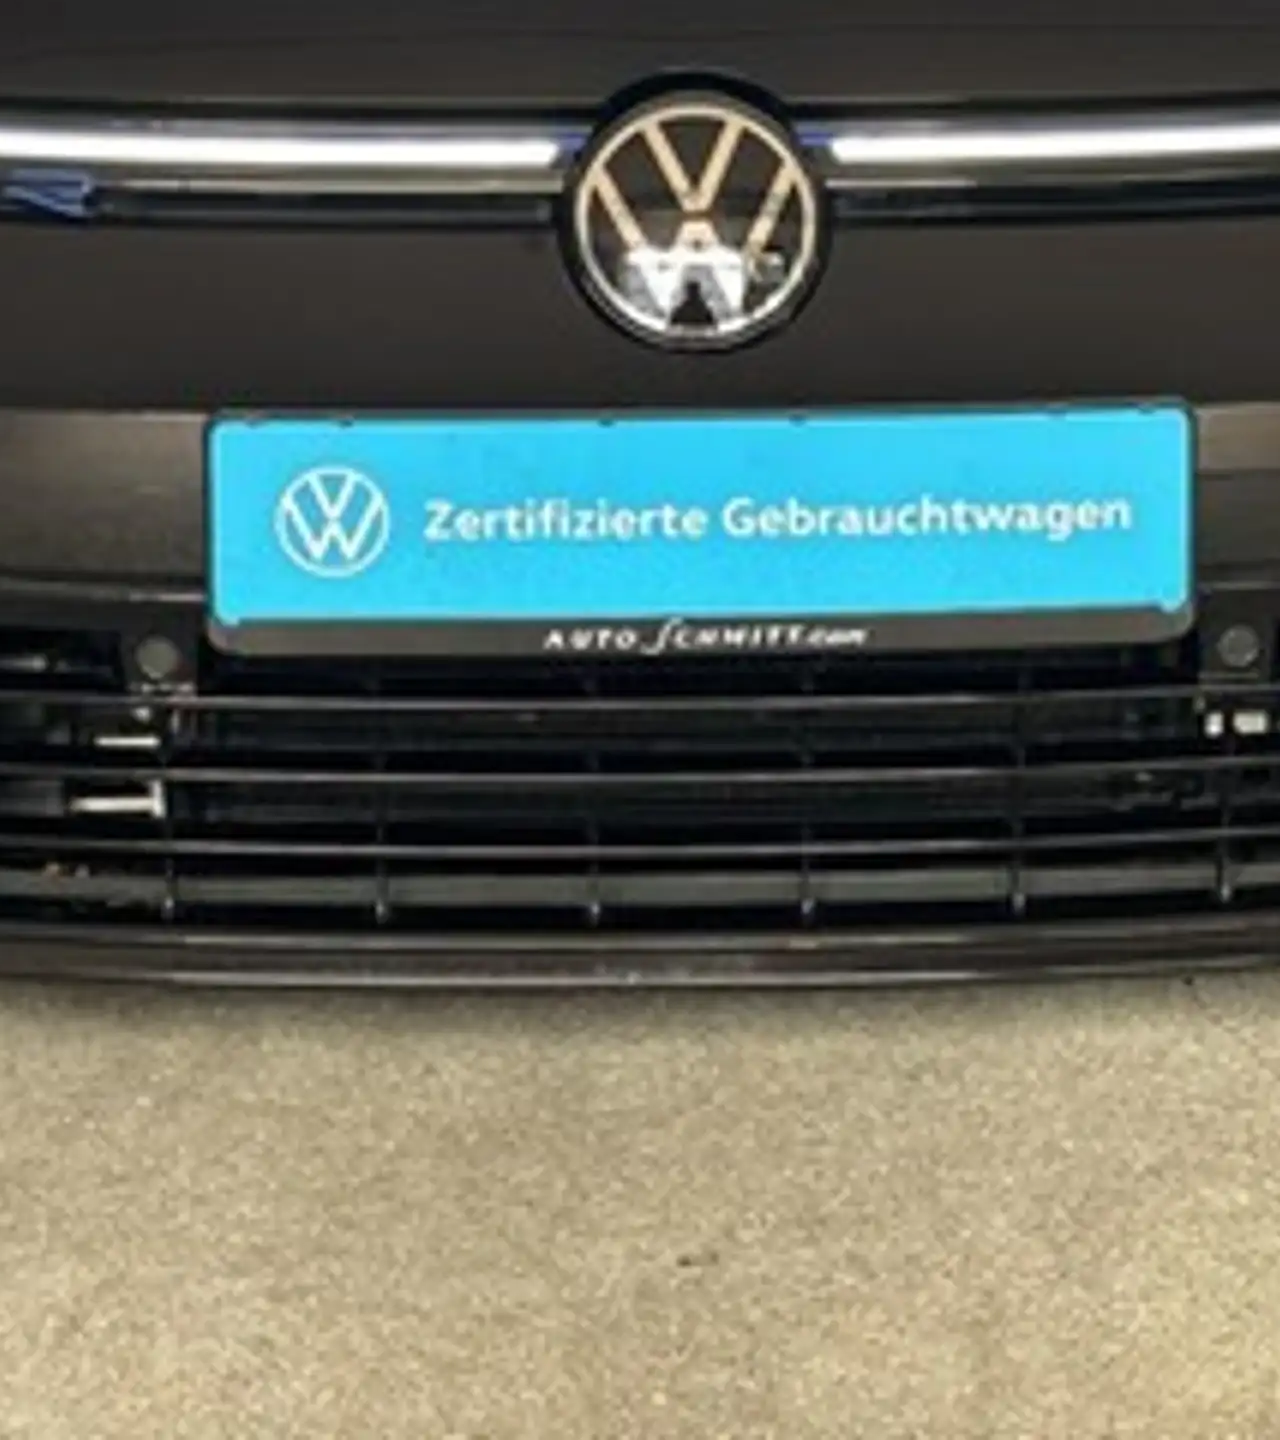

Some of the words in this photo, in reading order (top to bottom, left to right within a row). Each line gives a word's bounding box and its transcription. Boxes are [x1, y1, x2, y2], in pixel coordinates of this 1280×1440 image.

[423, 498, 708, 541] Zertifizierte
[723, 494, 1132, 541] Gebrauchtwagen
[542, 627, 637, 651] AUTO
